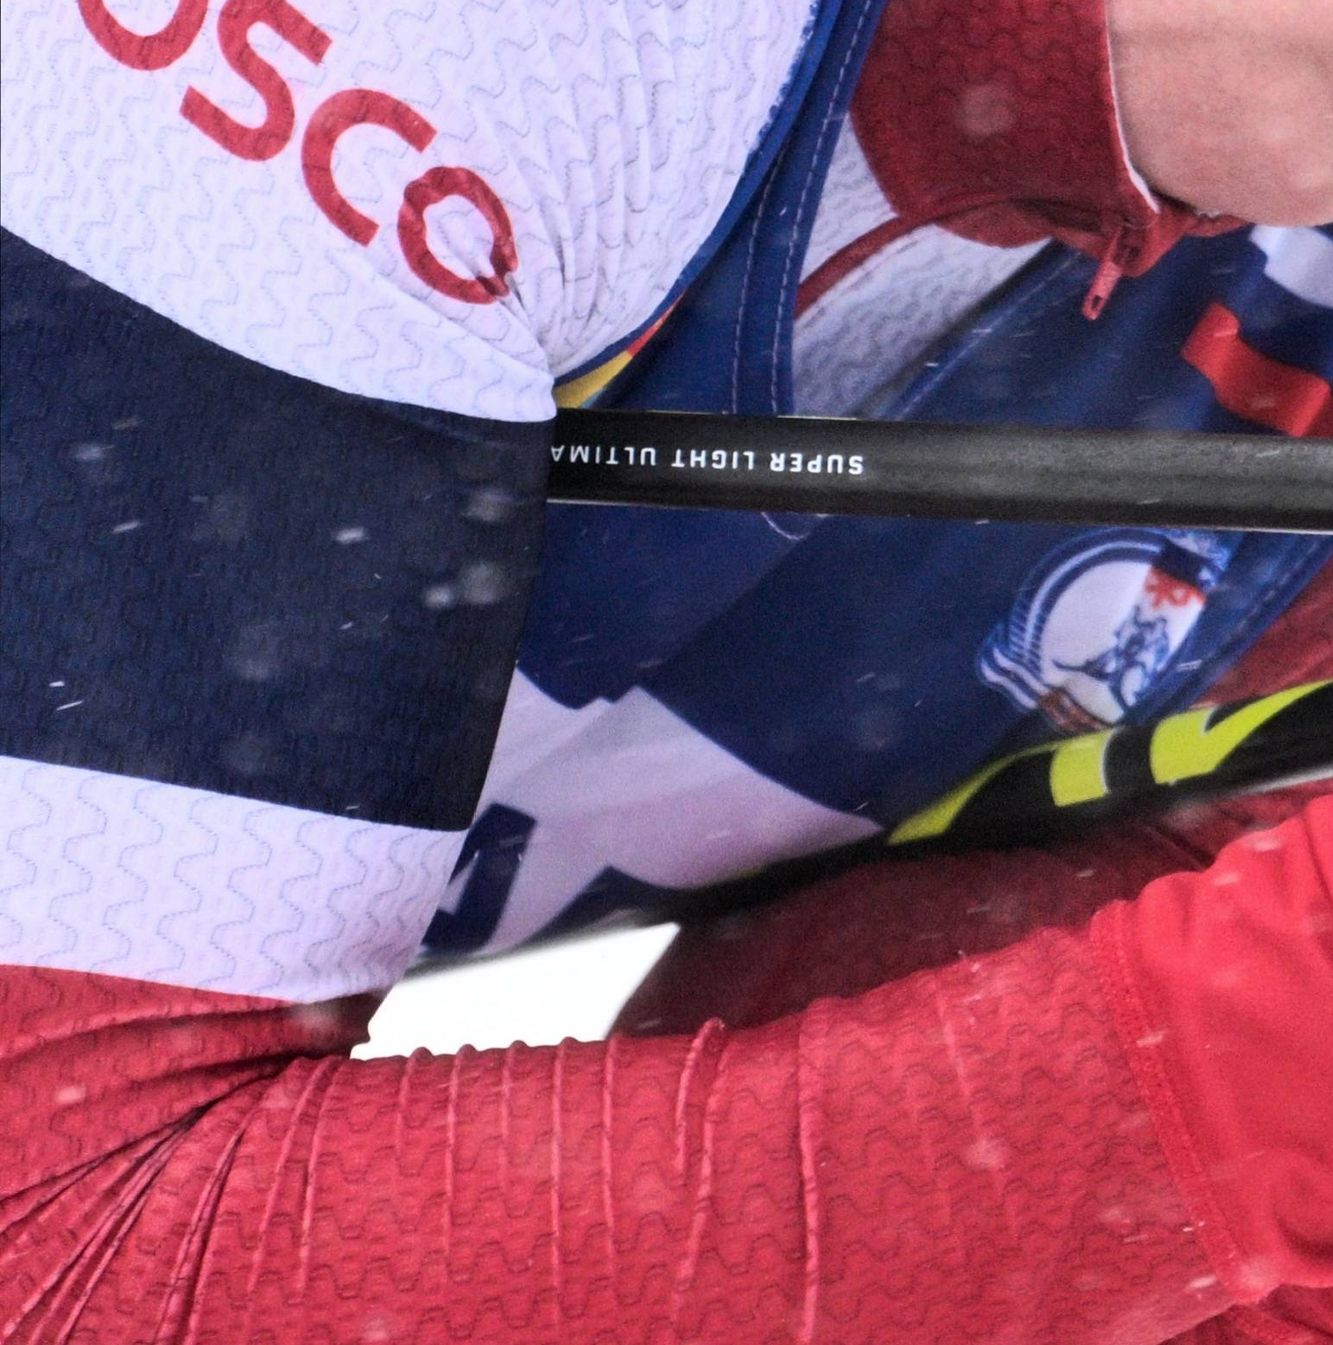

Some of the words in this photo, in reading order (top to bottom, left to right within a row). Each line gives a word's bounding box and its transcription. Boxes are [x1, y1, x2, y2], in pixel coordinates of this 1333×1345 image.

[550, 444, 657, 467] ULTIMA
[671, 448, 755, 471] LIGHT
[768, 452, 865, 476] SUPER
